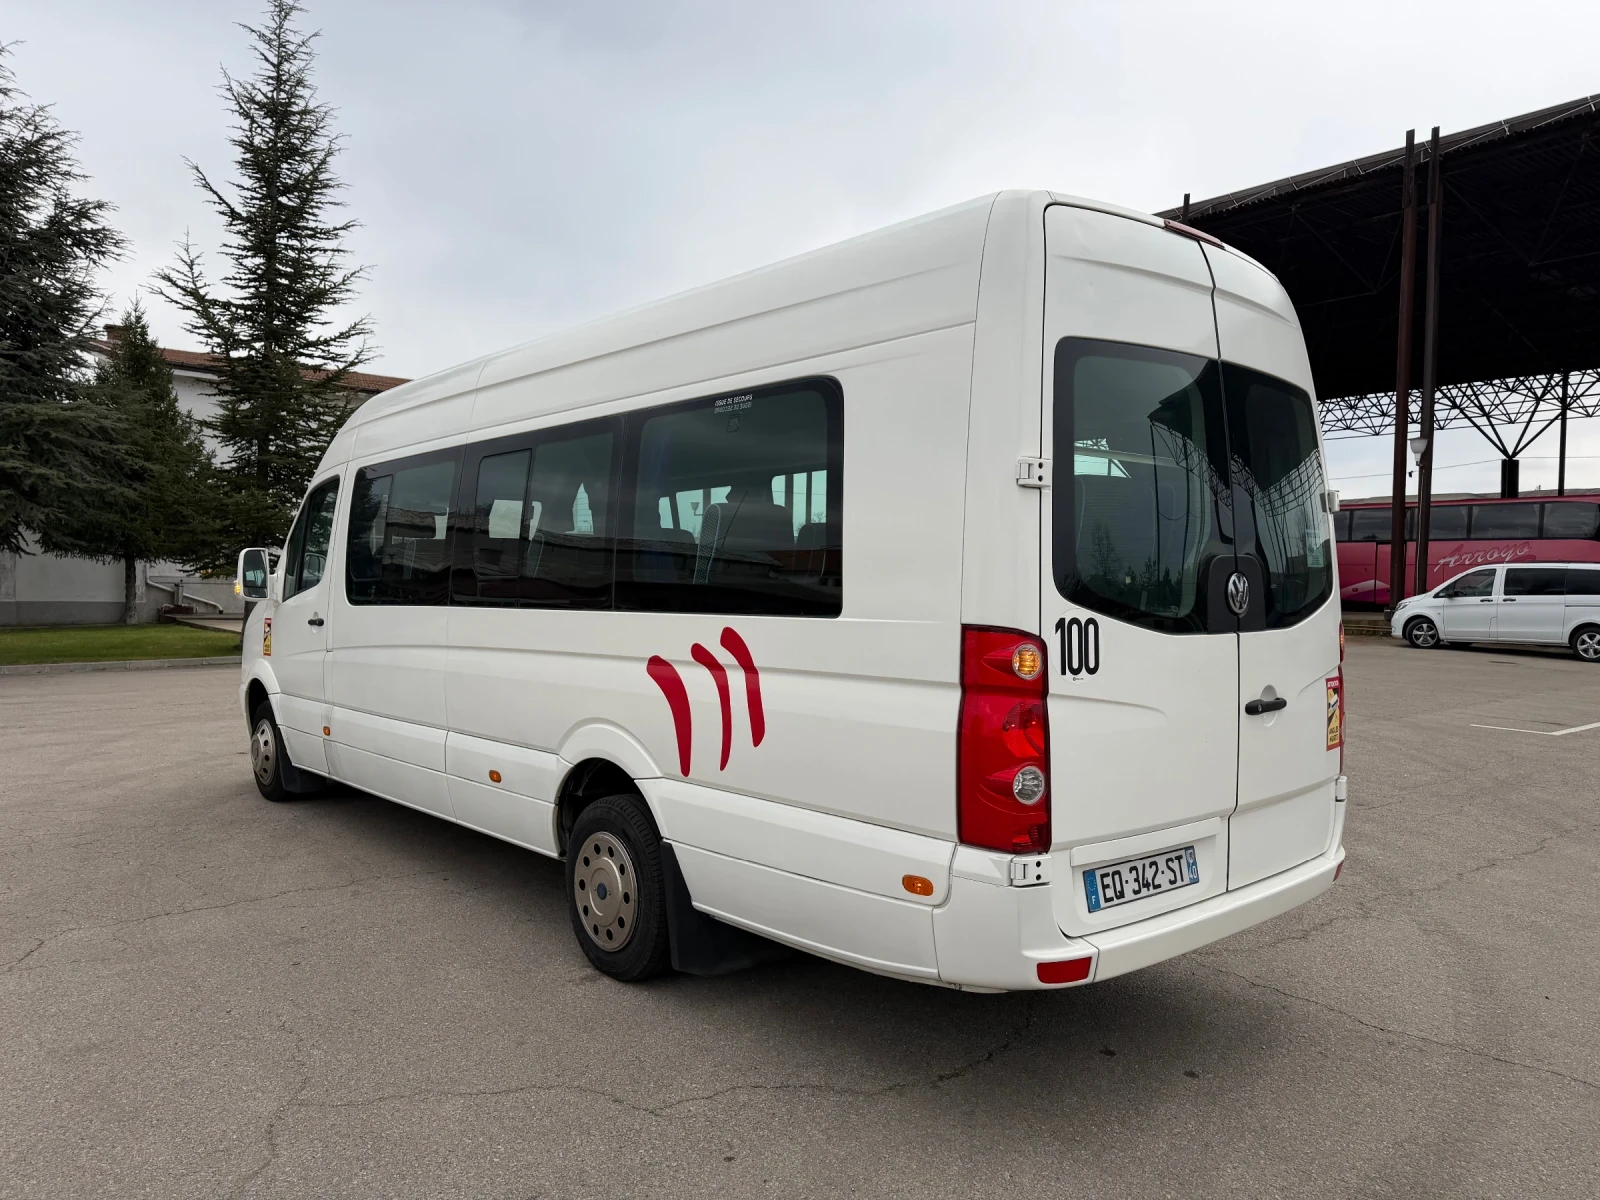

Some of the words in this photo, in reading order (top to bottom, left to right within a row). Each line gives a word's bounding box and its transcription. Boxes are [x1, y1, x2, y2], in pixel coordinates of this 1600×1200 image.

[714, 398, 727, 407] ISSUE
[733, 394, 753, 403] SECOURS
[1433, 541, 1533, 573] Arroyo
[1228, 572, 1249, 613] VW
[1055, 617, 1100, 675] 100
[1091, 895, 1096, 905] F
[1188, 865, 1198, 879] 40
